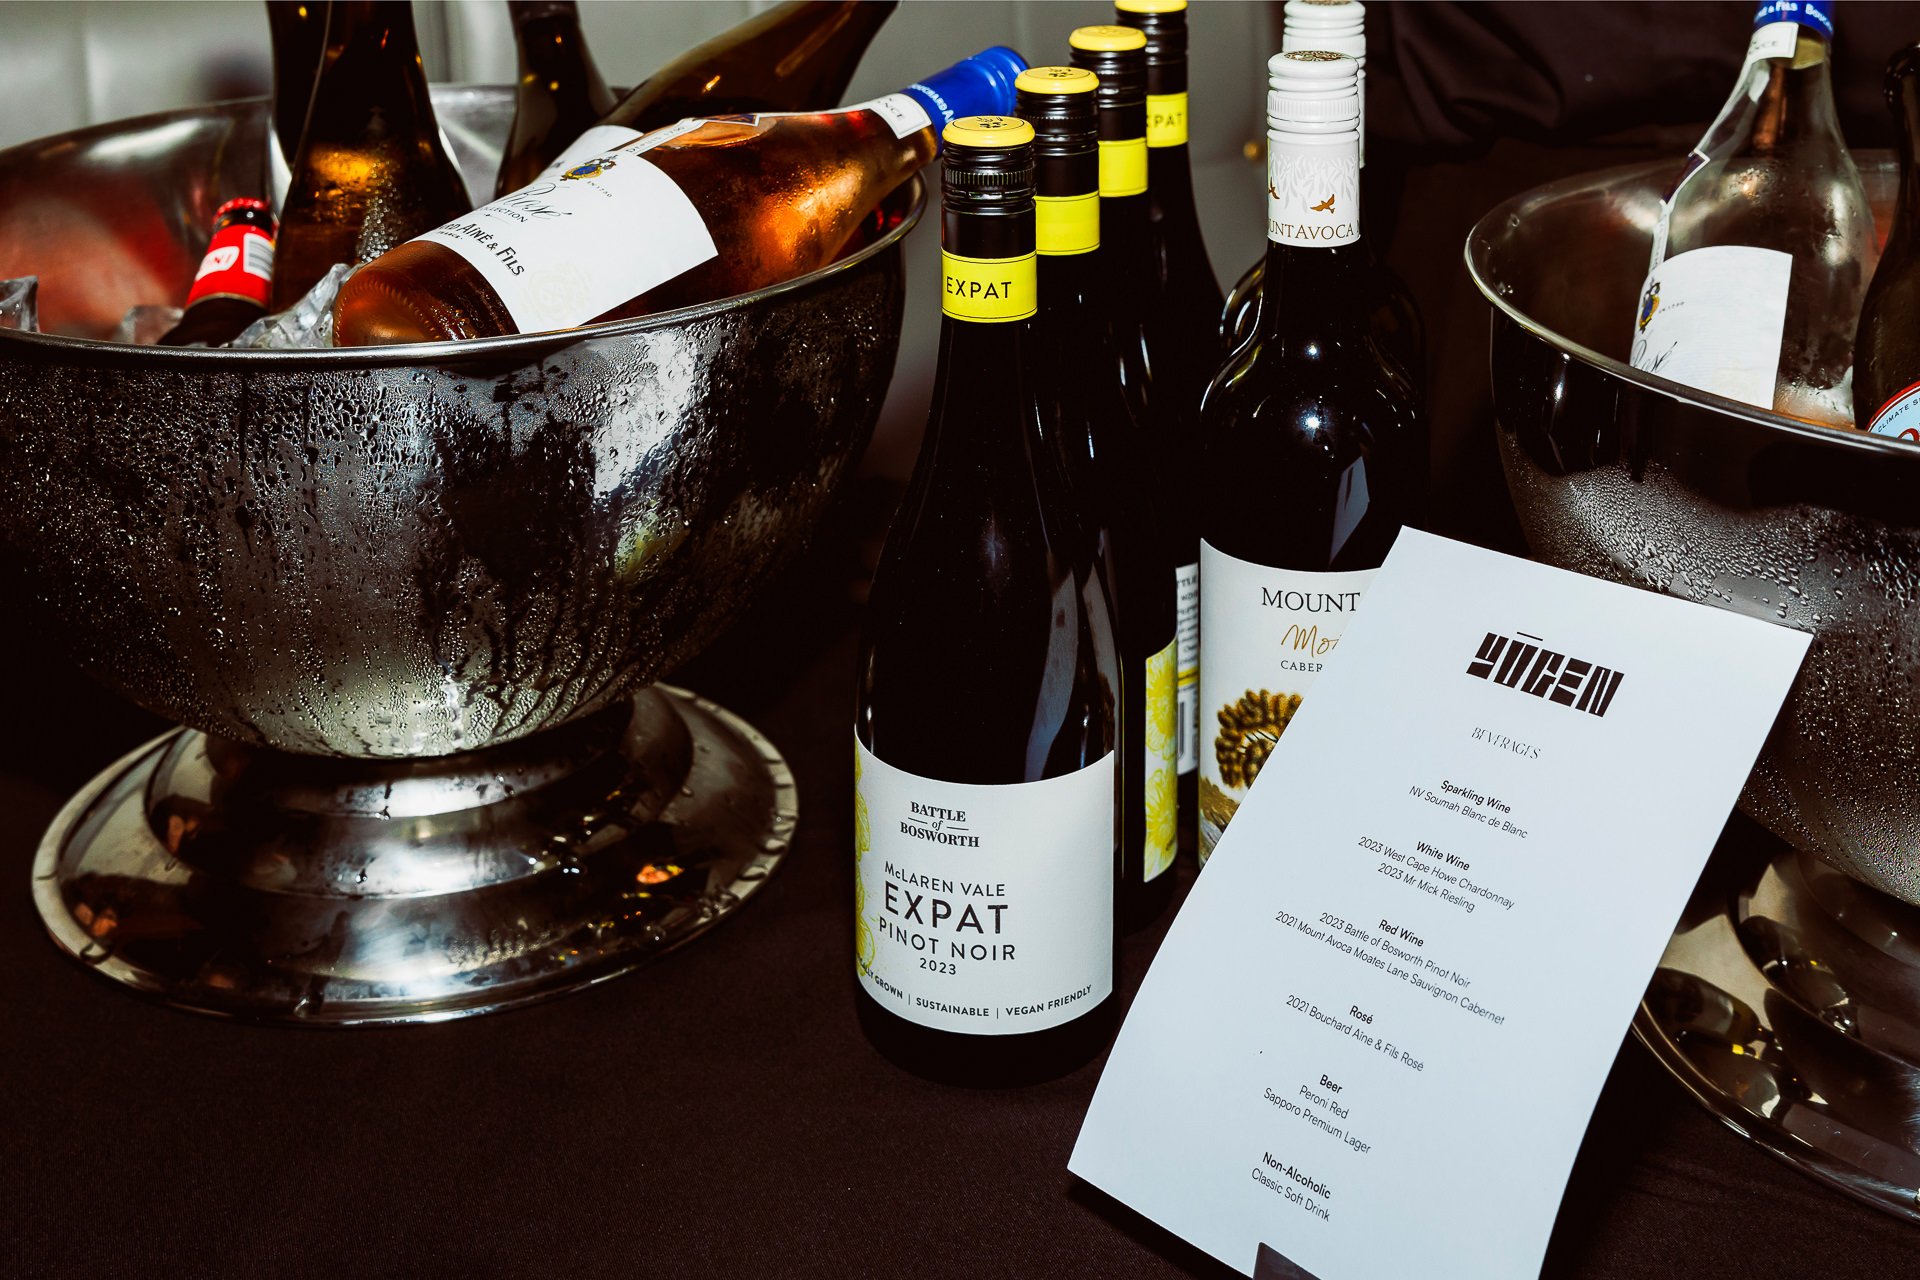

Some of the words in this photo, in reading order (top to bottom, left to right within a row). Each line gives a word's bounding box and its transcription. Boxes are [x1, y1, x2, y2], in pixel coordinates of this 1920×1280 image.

[486, 242, 499, 252] &
[495, 246, 525, 277] FILS
[946, 276, 1012, 299] EXPAT
[1877, 403, 1910, 433] CLIMATE
[1261, 586, 1361, 613] MOUNT
[1280, 660, 1323, 673] CABER
[909, 800, 966, 822] BATTLE
[1408, 785, 1426, 799] NV
[1424, 791, 1461, 813] Soumah
[1461, 805, 1487, 823] Blanc
[1487, 817, 1501, 828] de
[1501, 820, 1528, 839] Blanc
[1440, 780, 1485, 806] Sparkling
[1486, 796, 1511, 814] Wine
[899, 821, 980, 848] BOSWORTH
[931, 820, 944, 831] of
[1357, 836, 1384, 853] 2023
[1384, 846, 1406, 863] West
[1406, 856, 1431, 874] Cape
[1430, 866, 1458, 885] Howe
[1458, 877, 1515, 911] Chardonnay
[1416, 841, 1444, 860] White
[1446, 853, 1470, 871] Wine
[884, 860, 954, 894] McLAREN
[960, 882, 1006, 897] VALE
[1377, 862, 1404, 880] 2023
[1403, 873, 1417, 886] Mr
[1417, 879, 1440, 897] Mick
[1439, 888, 1476, 914] Riesling
[884, 880, 1009, 935] EXPAT
[879, 916, 940, 955] PINOT
[951, 941, 1016, 961] NOIR
[1319, 912, 1345, 931] 2023
[1344, 923, 1370, 943] Battle
[1370, 937, 1382, 948] of
[1381, 940, 1424, 968] Bosworth
[1424, 960, 1450, 980] Pinot
[1449, 971, 1472, 989] Noir
[1378, 919, 1399, 936] Red
[1399, 928, 1424, 947] Wine
[919, 957, 957, 976] 2023
[1275, 910, 1299, 928] 2021
[1297, 921, 1326, 941] Mount
[1324, 934, 1353, 955] Avoca
[1353, 947, 1386, 970] Moates
[1386, 962, 1409, 981] Lane
[1409, 973, 1459, 1004] Sauvignon
[1459, 996, 1506, 1026] Cabernet
[874, 975, 903, 1000] GROWN
[916, 997, 990, 1018] SUSTAINABLE
[1005, 1002, 1045, 1016] VEGAN
[1047, 984, 1093, 1011] FRIENDLY
[1349, 1004, 1374, 1025] Rosé
[1286, 994, 1310, 1013] 2021
[1309, 1005, 1353, 1035] Bouchard
[1351, 1028, 1374, 1046] Aine
[1374, 1038, 1384, 1051] &
[1383, 1043, 1400, 1060] Fils
[1400, 1051, 1425, 1072] Rosé
[1319, 1074, 1343, 1094] Beer
[1299, 1084, 1330, 1109] Peroni
[1329, 1101, 1350, 1120] Red
[1263, 1087, 1301, 1117] Sapporo
[1302, 1108, 1343, 1140] Premium
[1343, 1130, 1372, 1155] Lager
[1262, 1151, 1331, 1199] Non-Alcoholic
[1251, 1167, 1283, 1194] Classic
[1284, 1186, 1304, 1206] Soft
[1304, 1198, 1331, 1223] Drink
